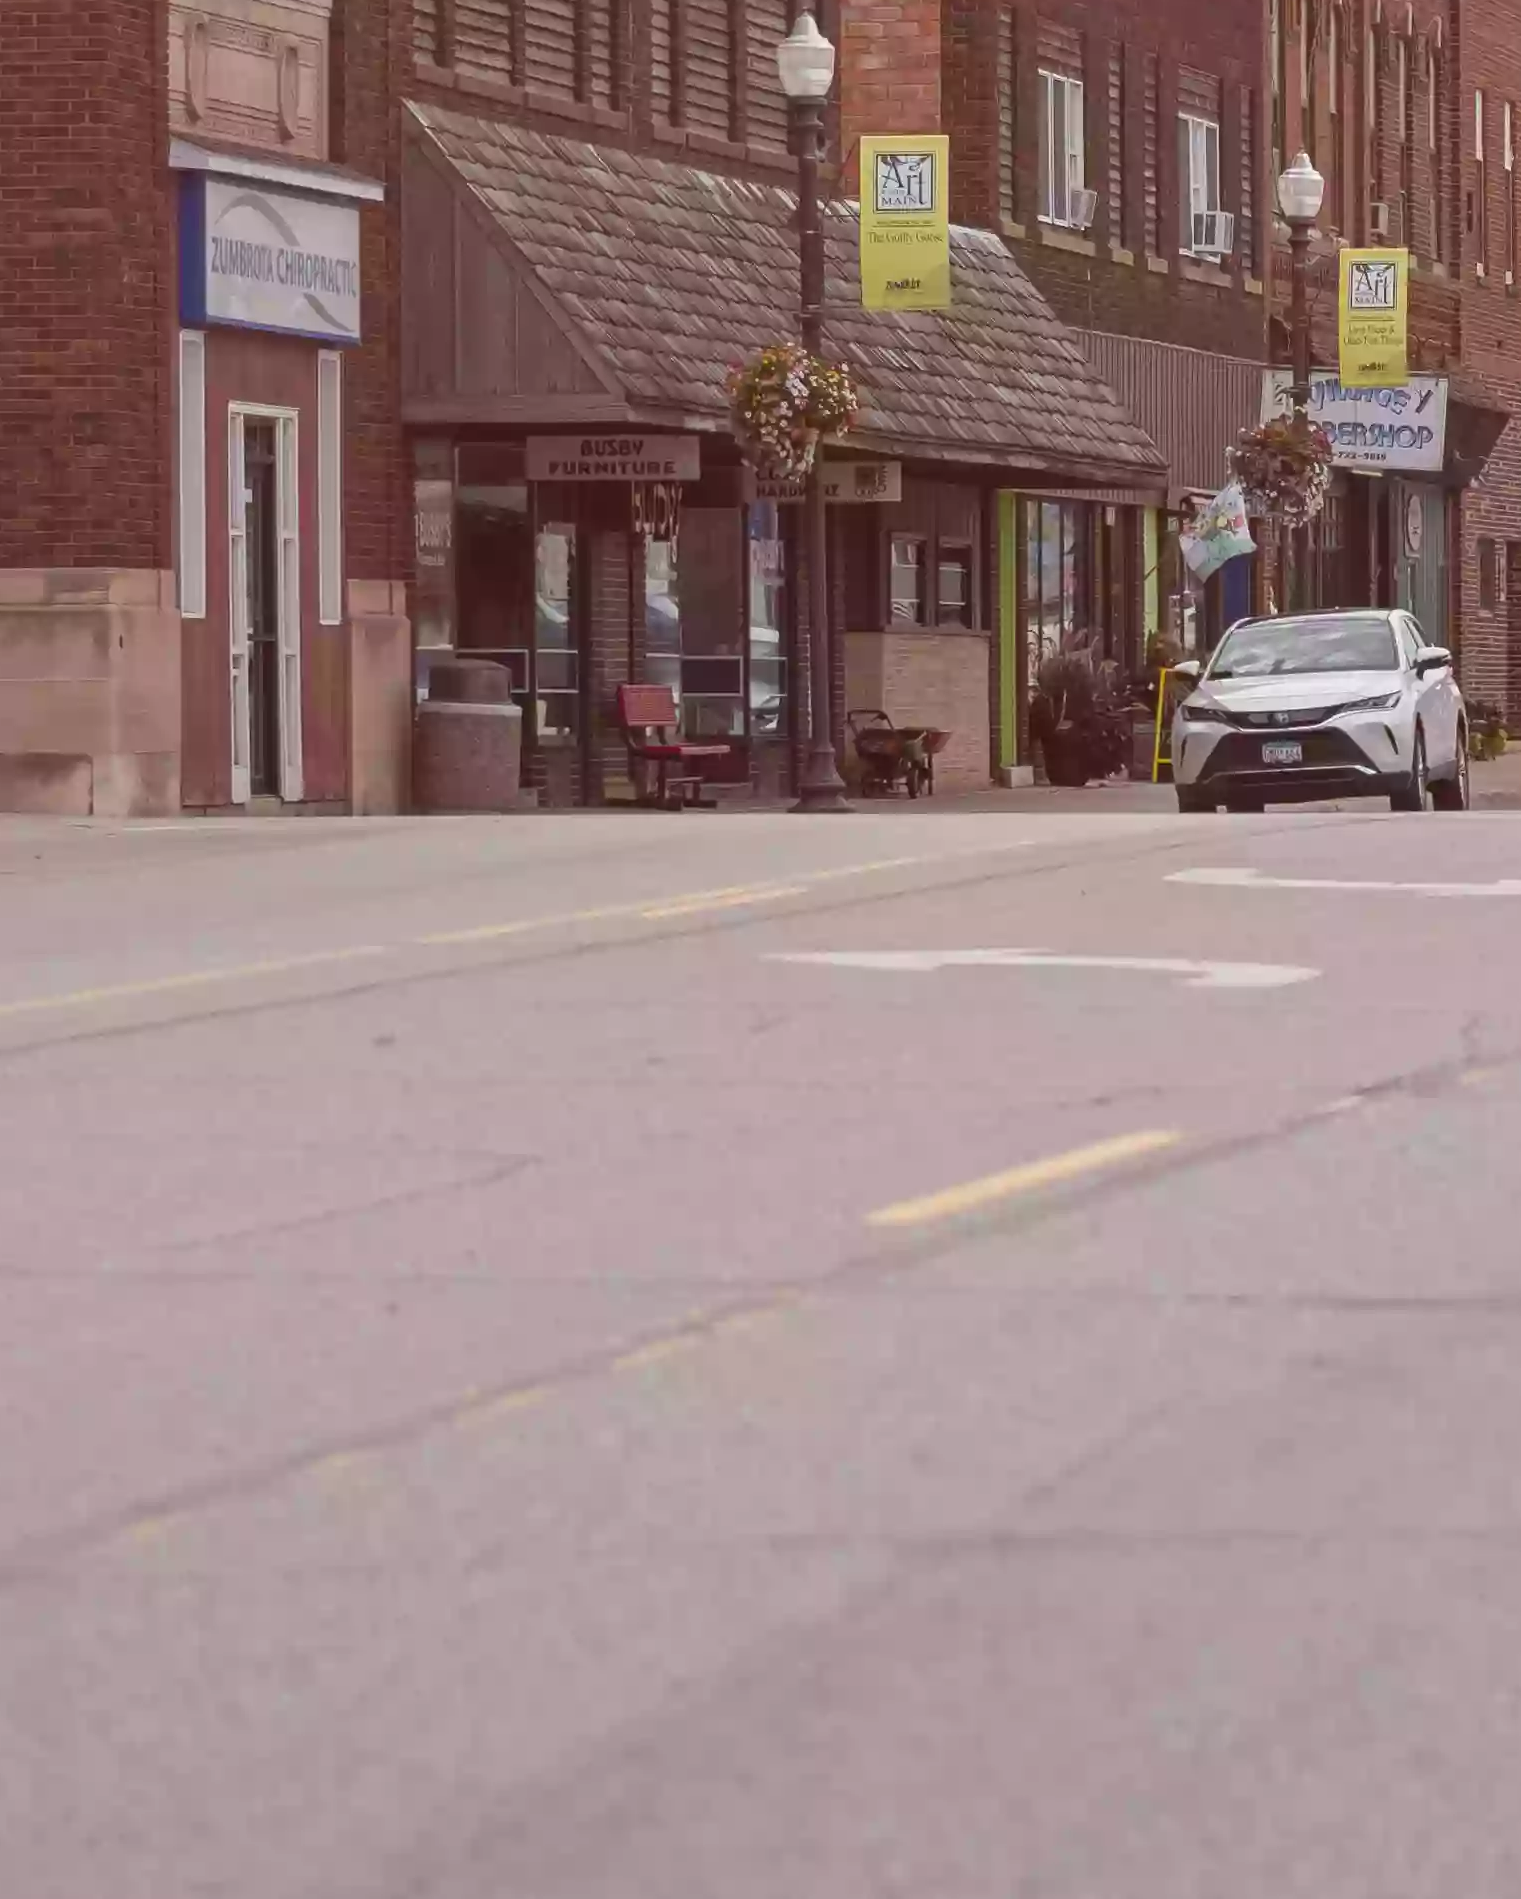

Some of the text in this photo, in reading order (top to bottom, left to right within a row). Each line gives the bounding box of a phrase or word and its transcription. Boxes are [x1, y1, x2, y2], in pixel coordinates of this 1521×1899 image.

[881, 155, 928, 205] Art
[881, 197, 917, 206] MAIN
[211, 235, 357, 298] ZUMBROTA CHIROPRACTIC
[1355, 264, 1392, 304] Art
[580, 438, 644, 457] BUSBY
[548, 460, 677, 476] FURNITURE
